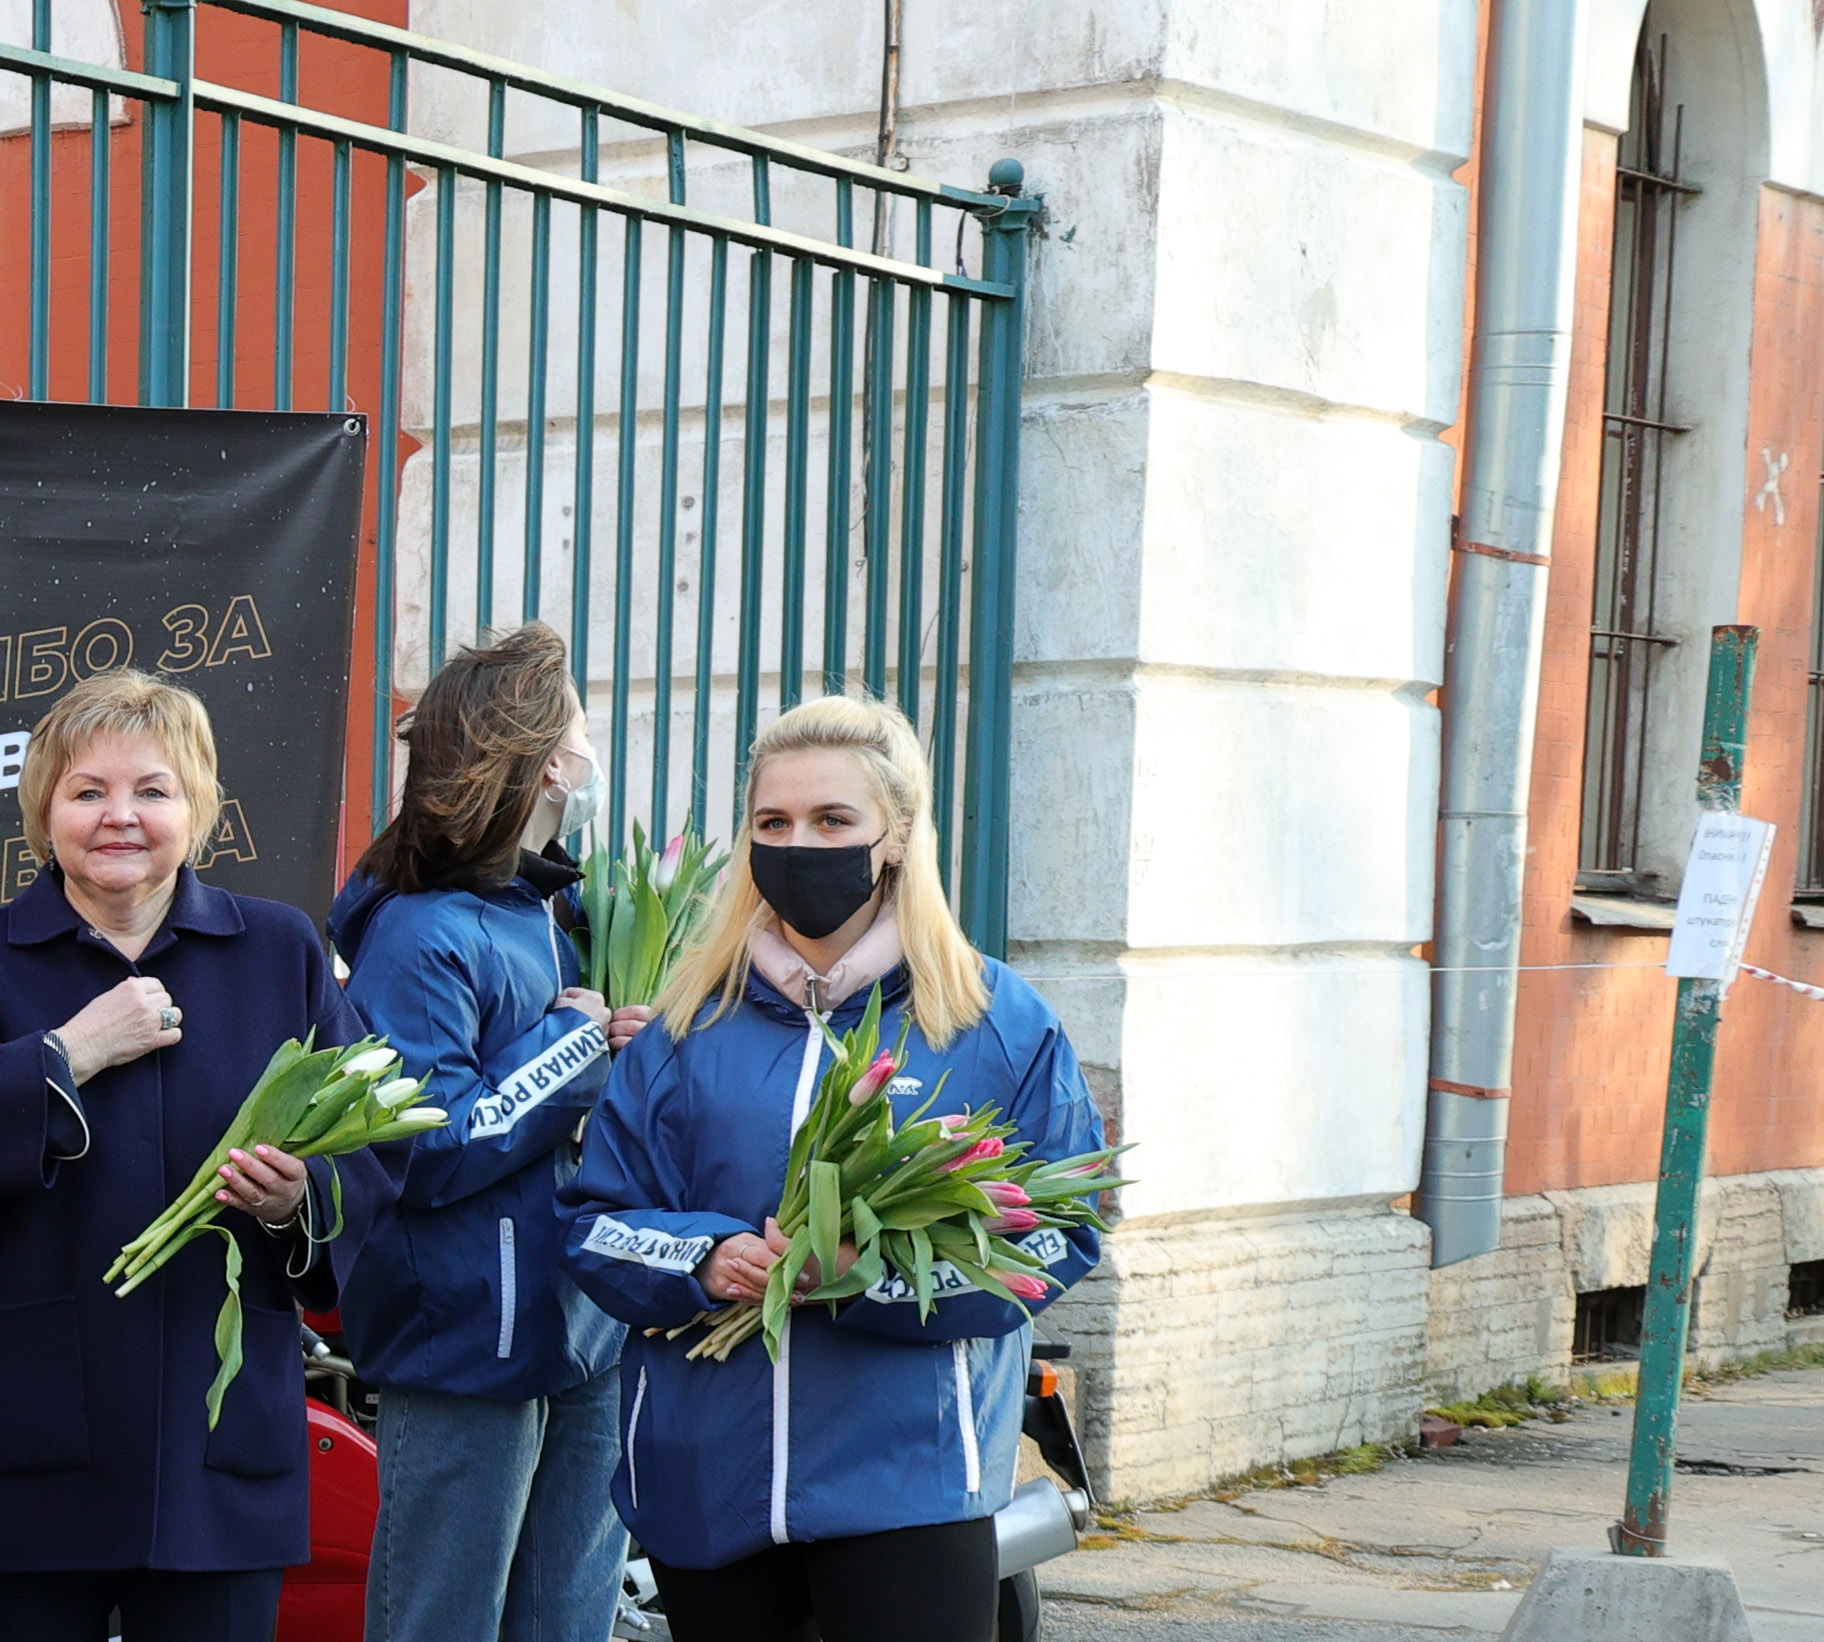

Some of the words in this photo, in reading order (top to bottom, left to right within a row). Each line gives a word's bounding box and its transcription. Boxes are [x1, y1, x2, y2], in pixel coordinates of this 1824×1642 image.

[158, 594, 272, 672] ЗА
[196, 799, 258, 869] А
[528, 1023, 608, 1090] ДИНАЯ
